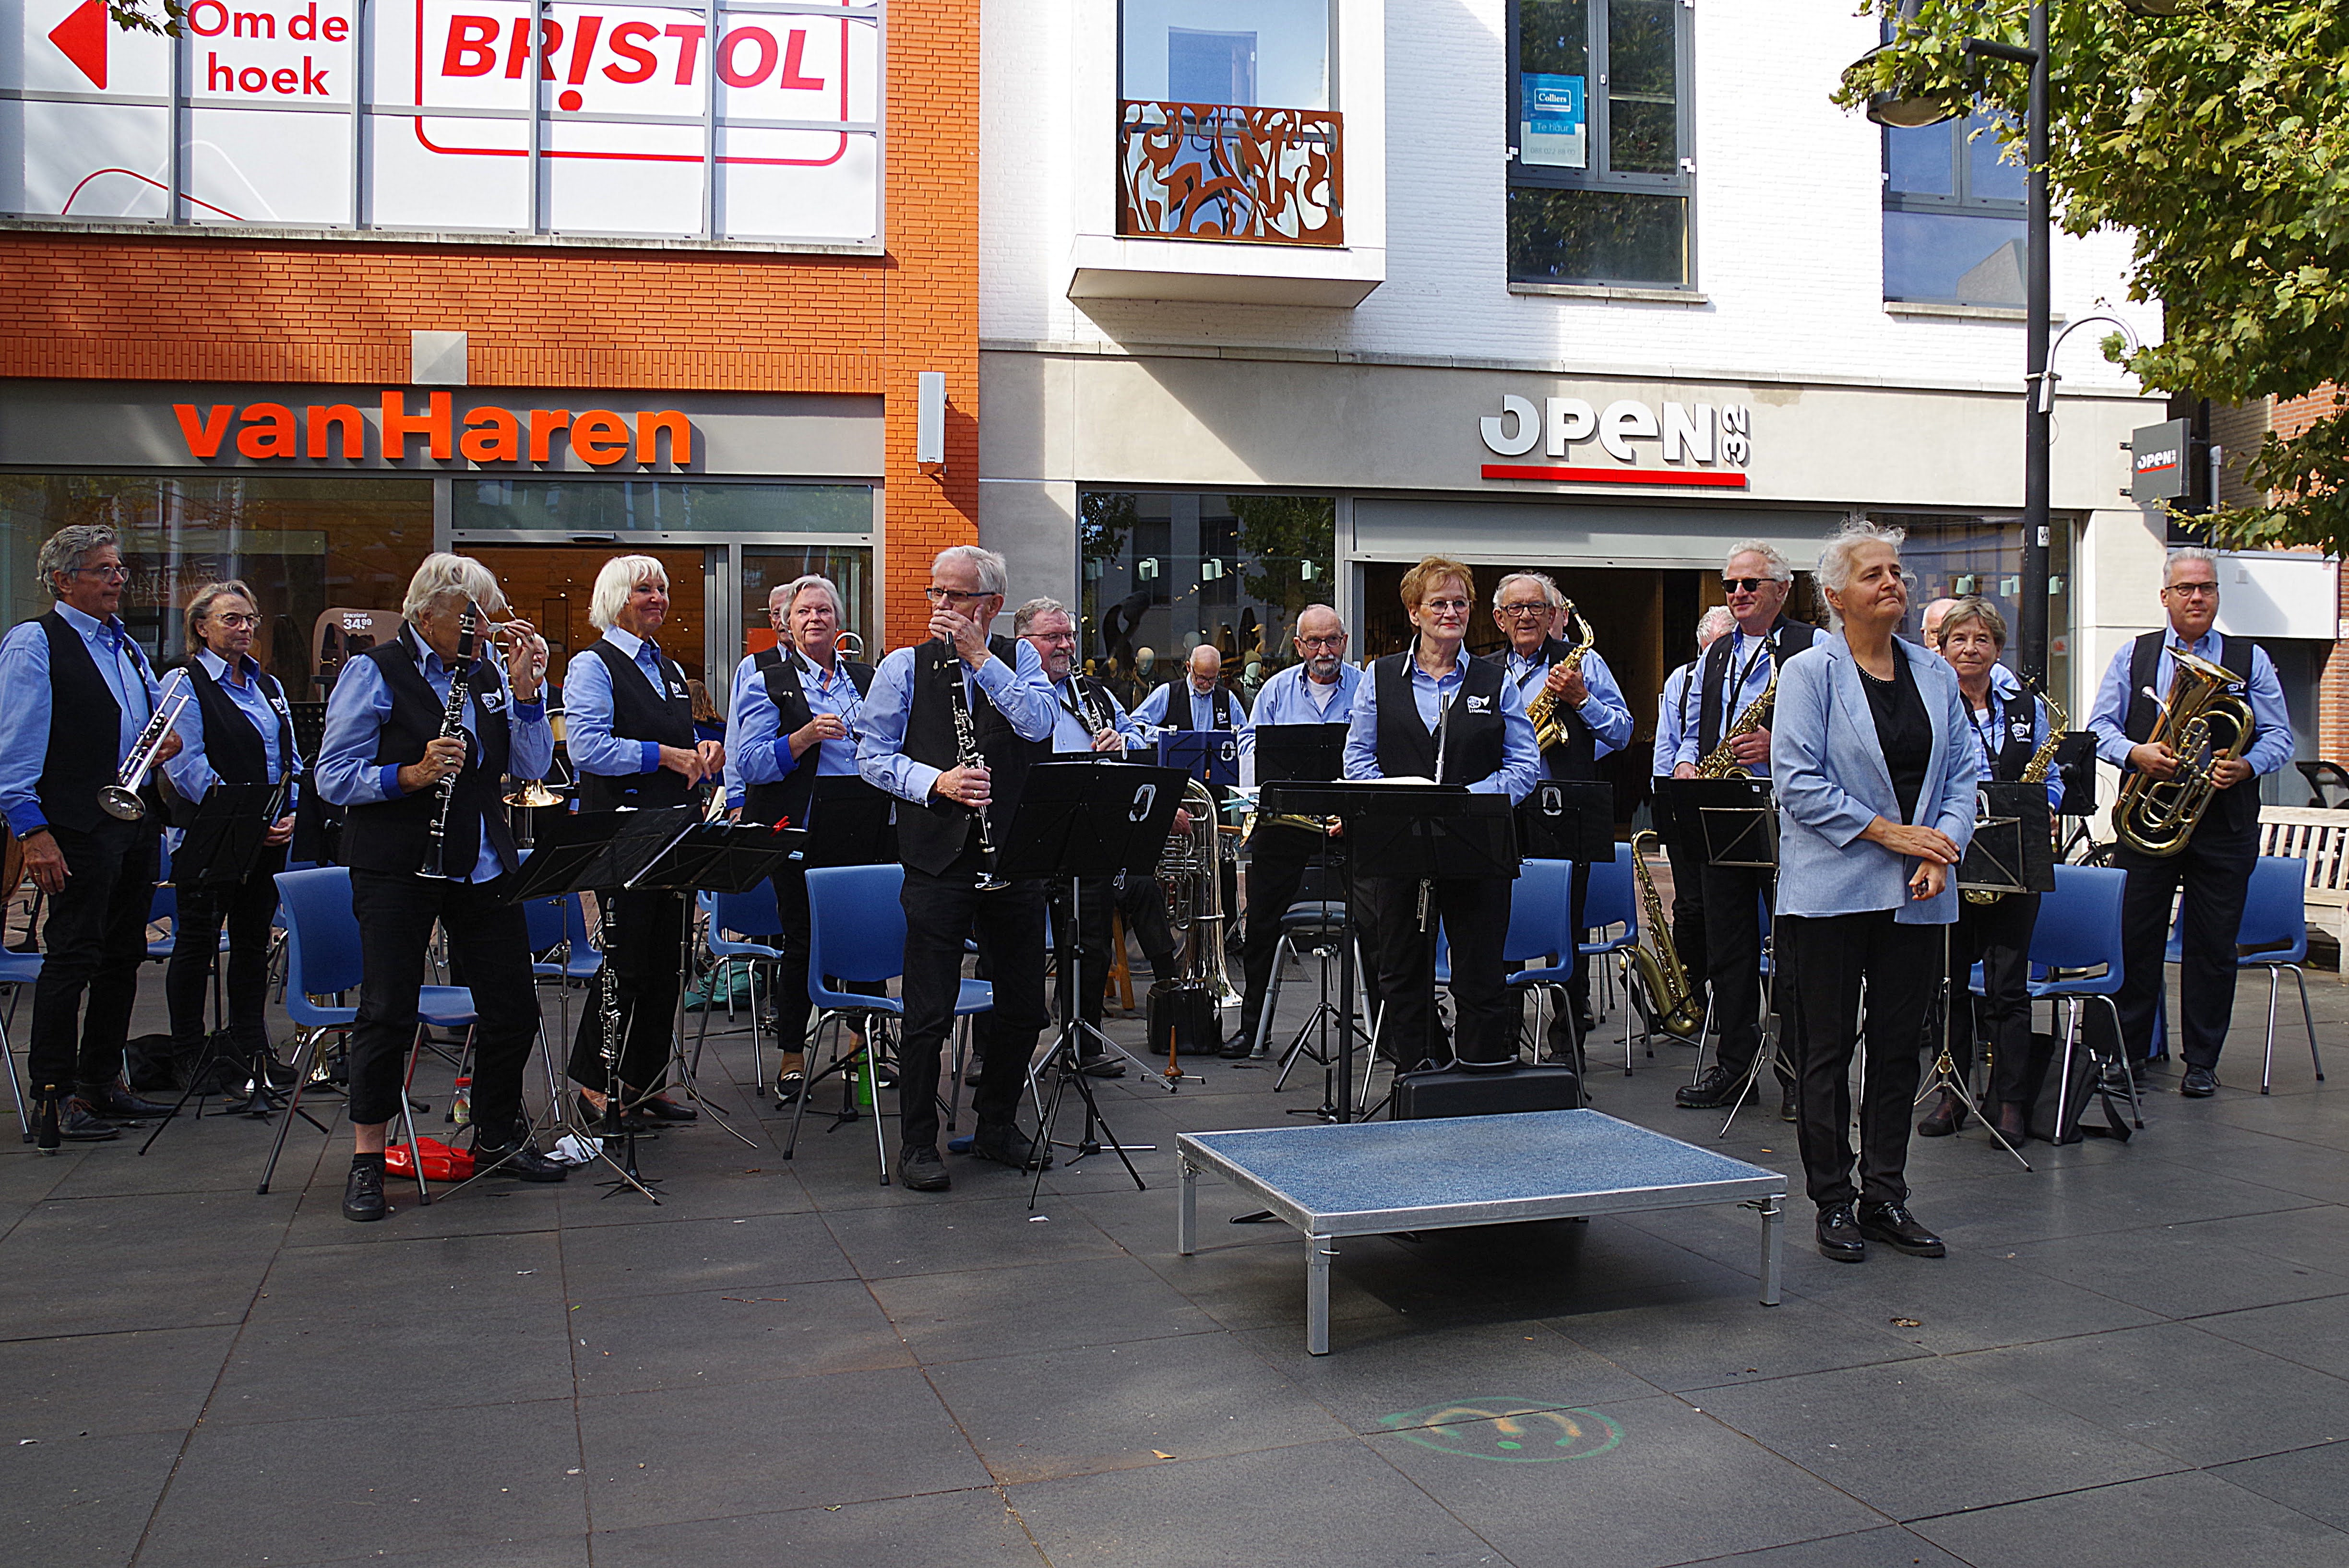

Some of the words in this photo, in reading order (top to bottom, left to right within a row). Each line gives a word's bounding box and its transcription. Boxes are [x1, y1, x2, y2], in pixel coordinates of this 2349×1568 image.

[188, 0, 275, 37] Om
[288, 2, 349, 42] de
[208, 51, 330, 96] hoek
[1538, 93, 1567, 103] Colliers
[1537, 122, 1547, 131] Te
[172, 390, 691, 466] vanHaren
[1721, 403, 1747, 463] 32
